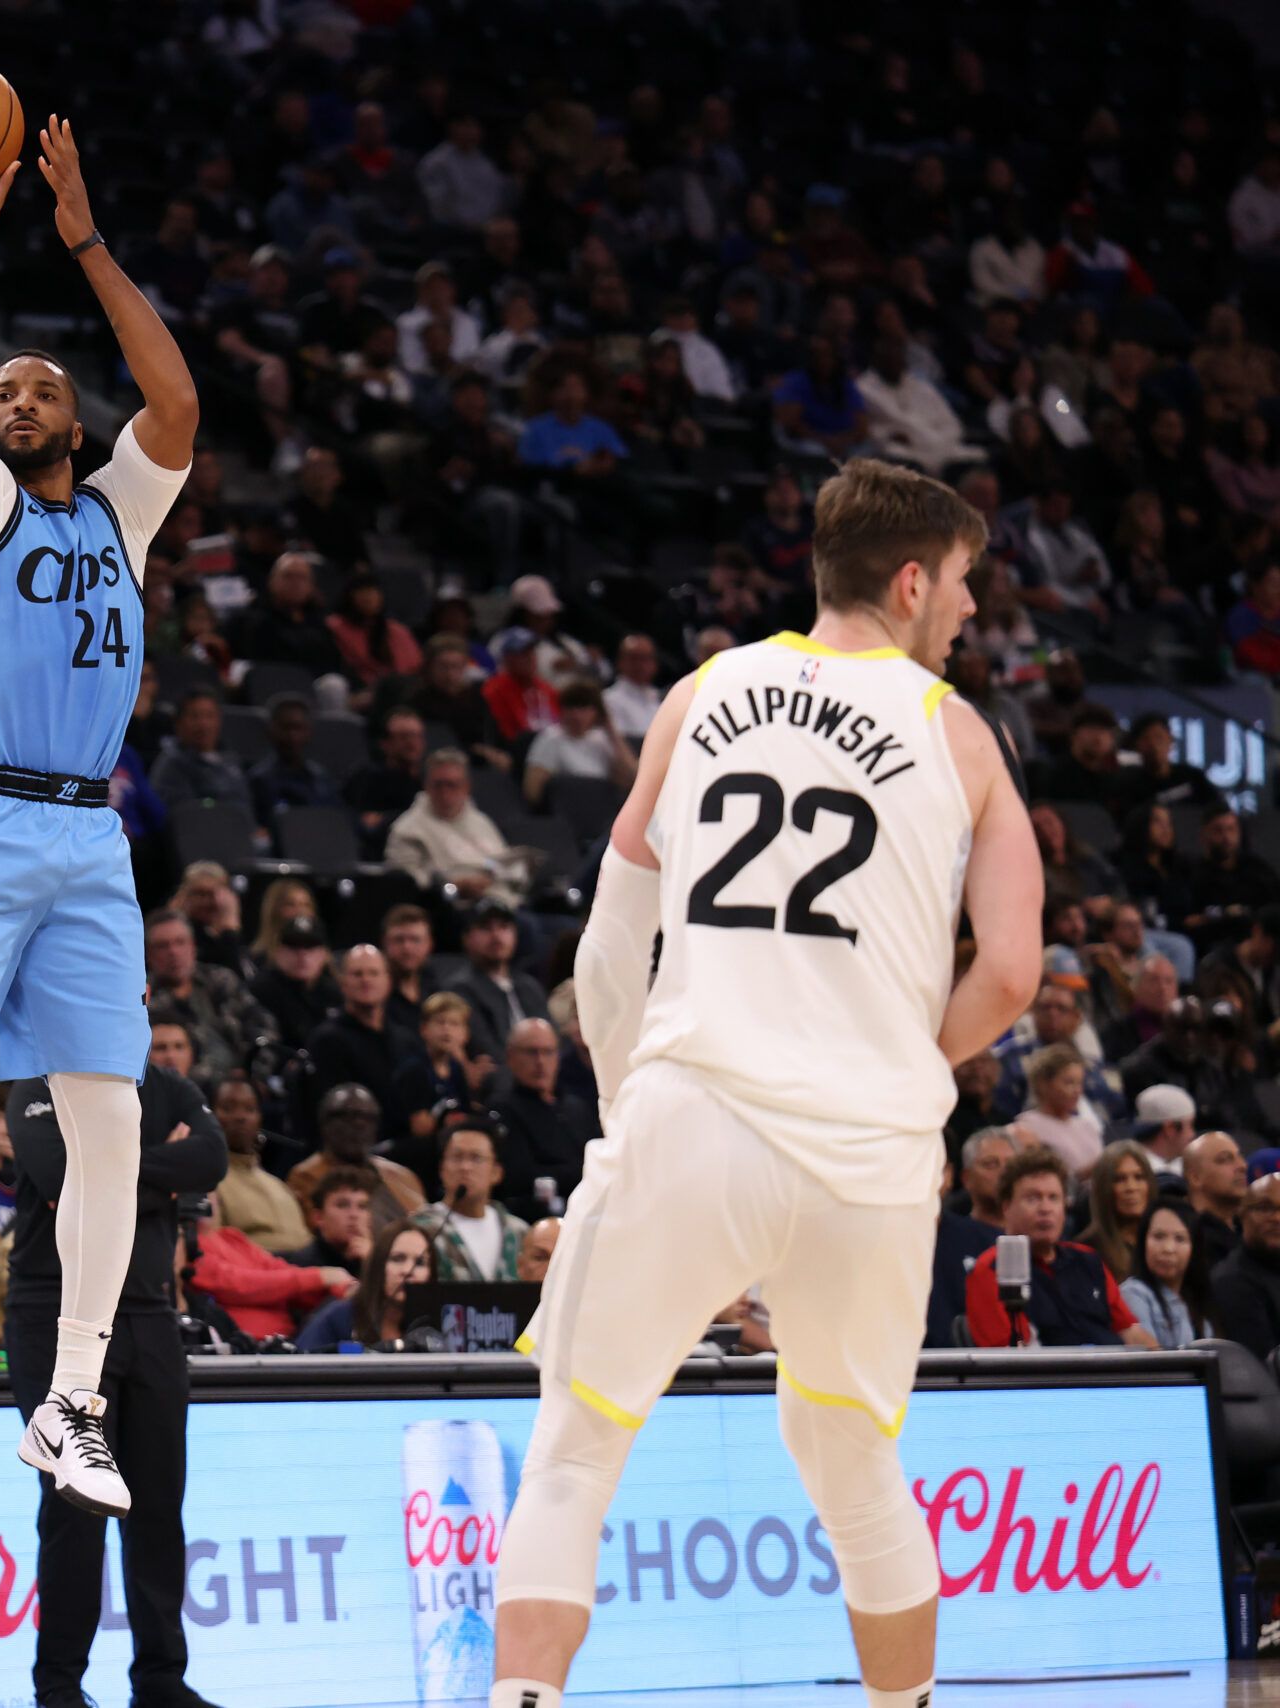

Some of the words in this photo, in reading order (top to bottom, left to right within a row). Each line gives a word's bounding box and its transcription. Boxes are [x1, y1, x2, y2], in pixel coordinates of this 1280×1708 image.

[16, 545, 120, 604] Clps
[71, 607, 130, 669] 24
[691, 686, 916, 786] FILIPOWSKI
[686, 772, 878, 947] 22
[402, 1488, 501, 1568] Coor
[594, 1513, 842, 1605] HOOS
[911, 1461, 1162, 1599] Chill
[99, 1533, 347, 1631] LGHT
[413, 1569, 496, 1613] LIGH
